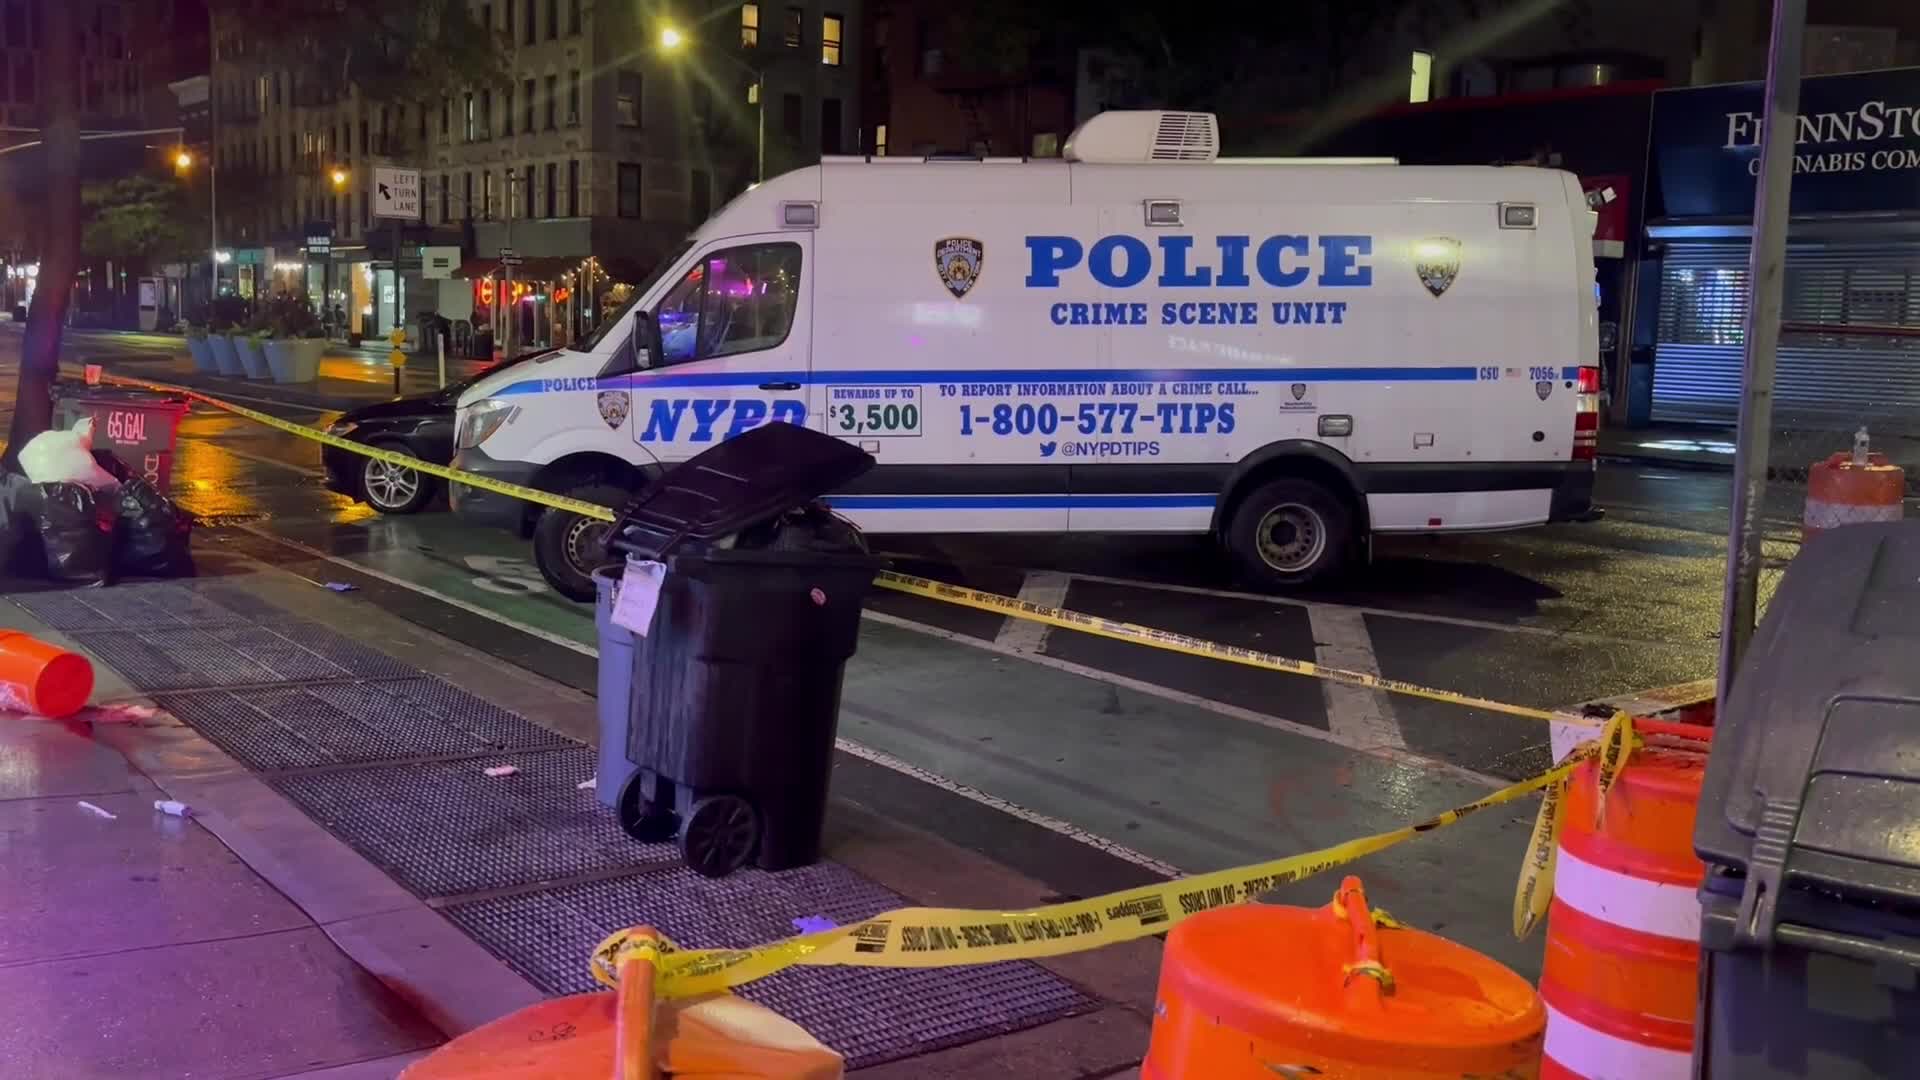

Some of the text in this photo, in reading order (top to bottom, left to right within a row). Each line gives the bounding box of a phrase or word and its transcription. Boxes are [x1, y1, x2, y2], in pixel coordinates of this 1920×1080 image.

[1723, 101, 1920, 149] FNNST
[1748, 152, 1865, 176] CNABIS
[393, 175, 415, 185] LEFT
[393, 188, 416, 198] TURN
[393, 201, 416, 212] LANE
[1025, 235, 1373, 288] POLICE
[1051, 302, 1347, 325] CRIME SCENE UNIT
[1480, 367, 1499, 380] CSU
[1529, 367, 1554, 380] 7056
[544, 377, 597, 392] POLICE
[834, 389, 914, 399] REWARDS UP TO
[939, 383, 1259, 397] TO REPORT INFORMATION ABOUT A CRIME CALL...
[107, 412, 147, 440] 65 GAL
[960, 402, 1235, 435] 1-800-577-TIPS
[1062, 441, 1160, 458] @NYPDTIPS
[1179, 890, 1207, 914] CROSS
[1207, 886, 1224, 911] NOT
[1223, 884, 1235, 905] DO
